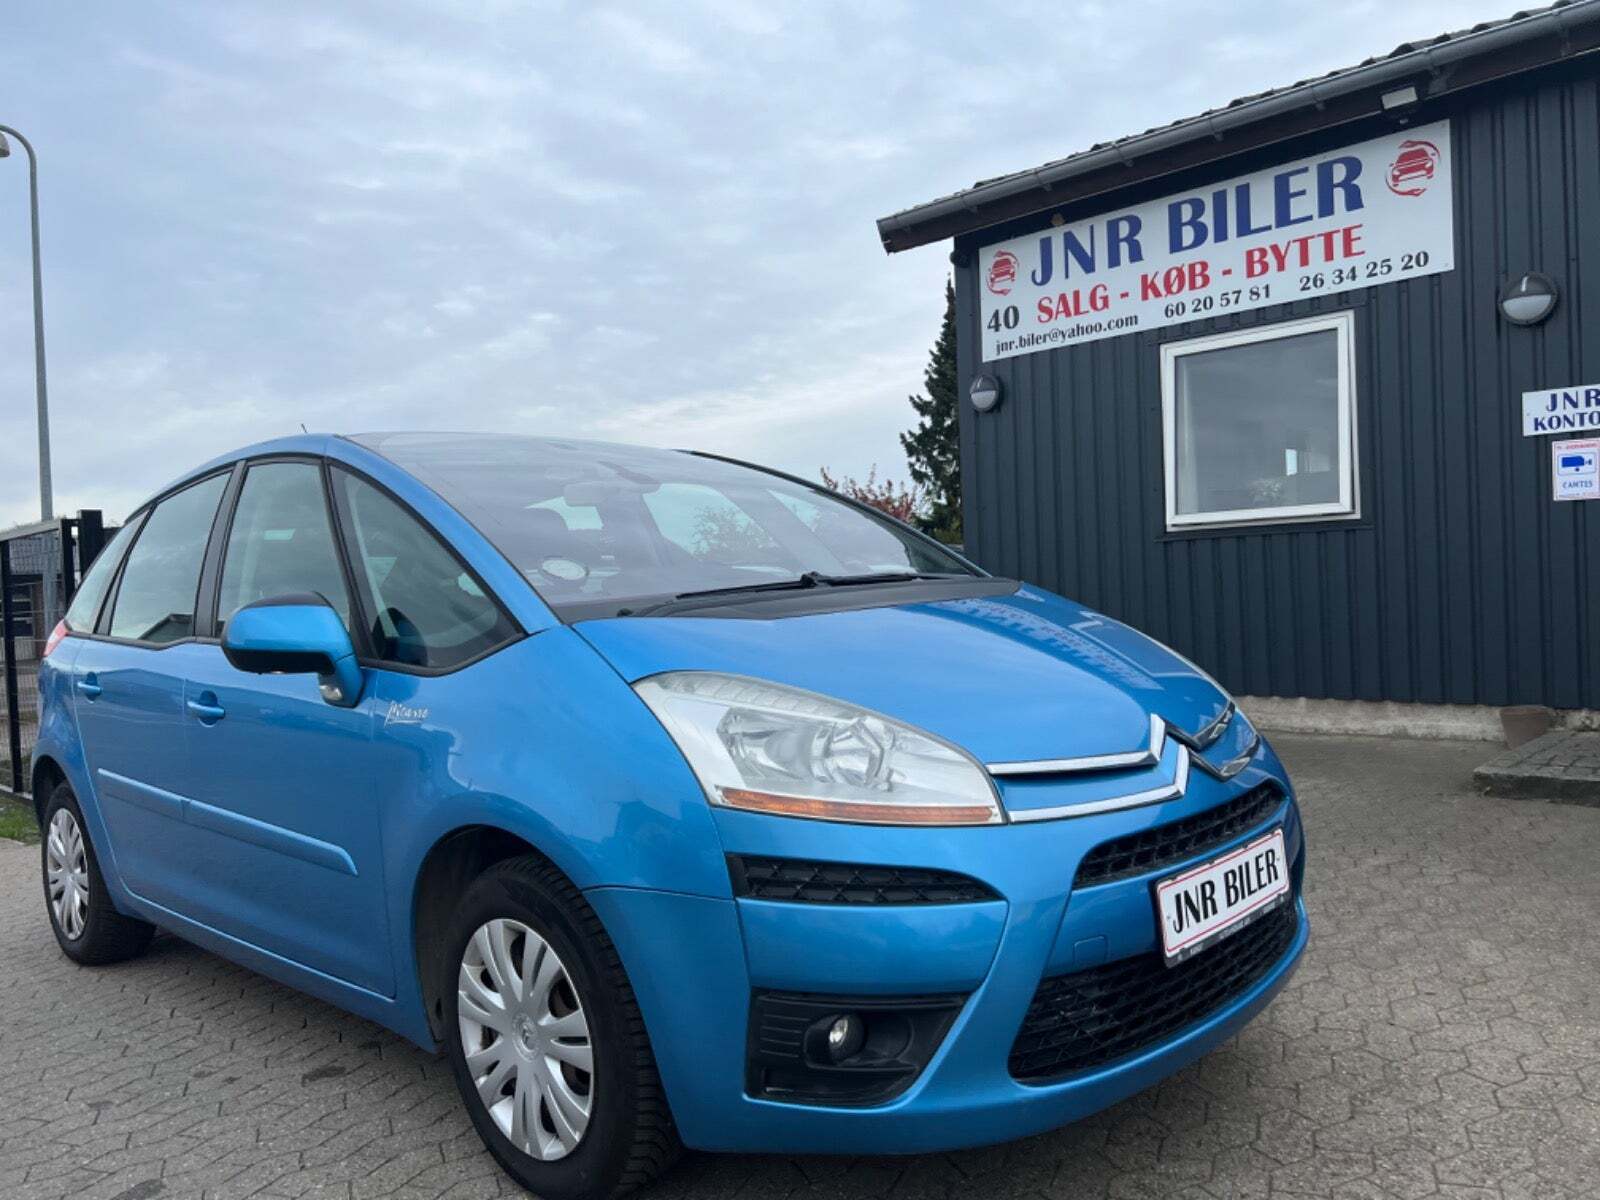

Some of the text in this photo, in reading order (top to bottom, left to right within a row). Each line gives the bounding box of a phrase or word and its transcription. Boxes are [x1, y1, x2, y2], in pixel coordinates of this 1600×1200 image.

[1031, 155, 1365, 286] JNR BILER
[1037, 283, 1110, 323] SALG
[1140, 260, 1211, 302] KØB
[1245, 224, 1366, 279] BYTTE
[1299, 250, 1429, 292] 26 34 25 20
[986, 305, 1020, 333] 40
[1164, 283, 1271, 319] 60 20 57 81
[996, 313, 1139, 356] jnr.biler@yahoo.com
[1533, 410, 1600, 432] KONTO
[1546, 388, 1600, 412] JNR
[1173, 879, 1218, 934] JNR
[1223, 848, 1279, 908] BILER
